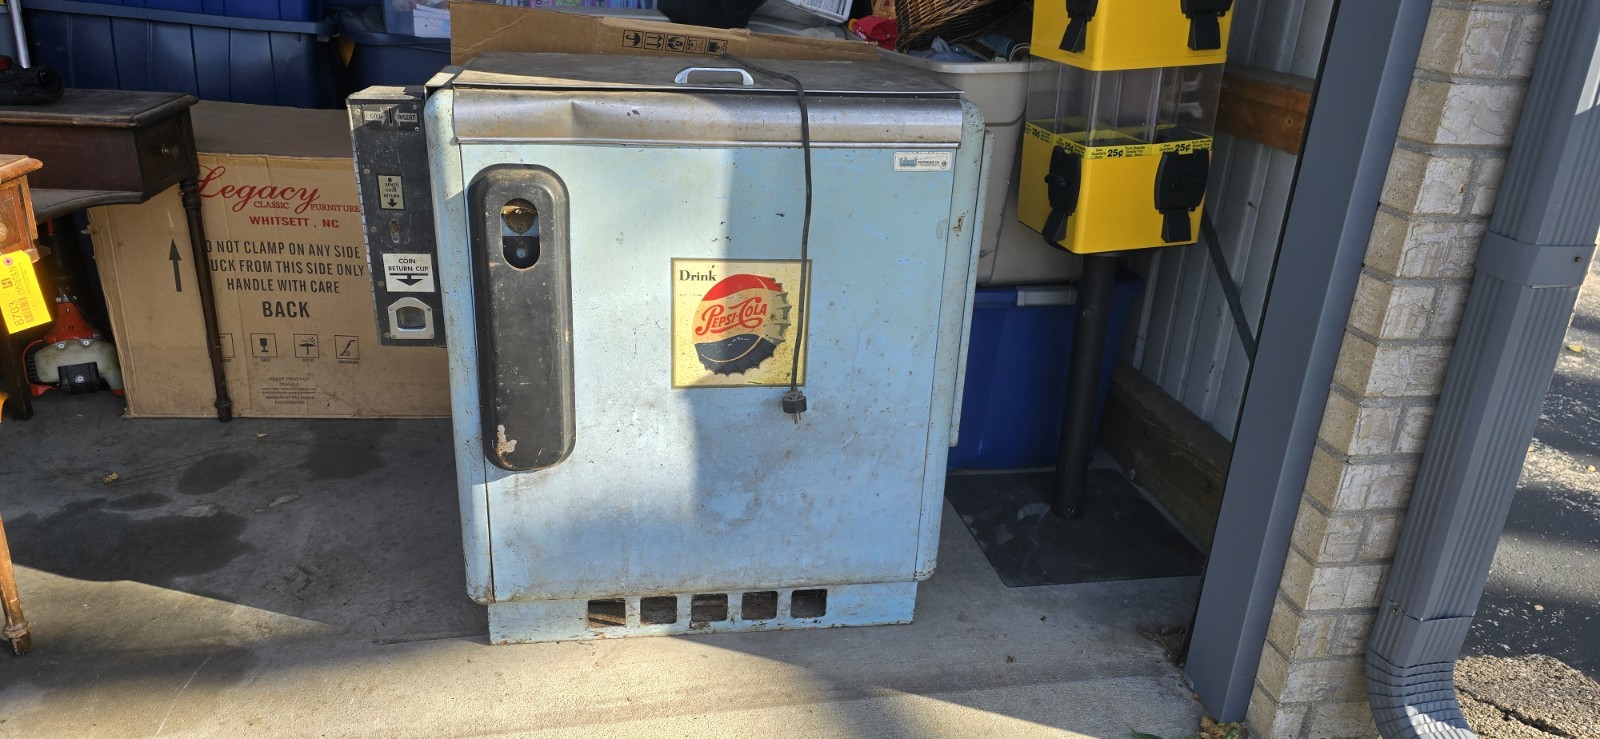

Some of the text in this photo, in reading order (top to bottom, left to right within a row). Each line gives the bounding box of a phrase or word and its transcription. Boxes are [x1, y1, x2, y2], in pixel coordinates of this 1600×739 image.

[1107, 148, 1124, 158] 25¢
[1174, 143, 1191, 154] 25¢
[178, 164, 320, 214] Legacy
[254, 201, 290, 210] CLASSIC
[310, 204, 360, 213] FURNITURE
[250, 216, 310, 227] WHITSETT
[322, 220, 340, 228] NC
[216, 240, 239, 253] NOT
[244, 241, 284, 255] CLAMP
[289, 243, 304, 255] ON
[308, 244, 330, 257] ANY
[334, 245, 360, 258] SIDE
[211, 259, 364, 277] UCK FROM THIS SIDE ONLY
[679, 270, 717, 281] Drink
[9, 266, 25, 295] HANSEN
[227, 278, 340, 293] HANDLE WITH CARE
[8, 300, 24, 326] 8703
[262, 301, 310, 318] BACK
[695, 296, 768, 336] PEPSI-COLA
